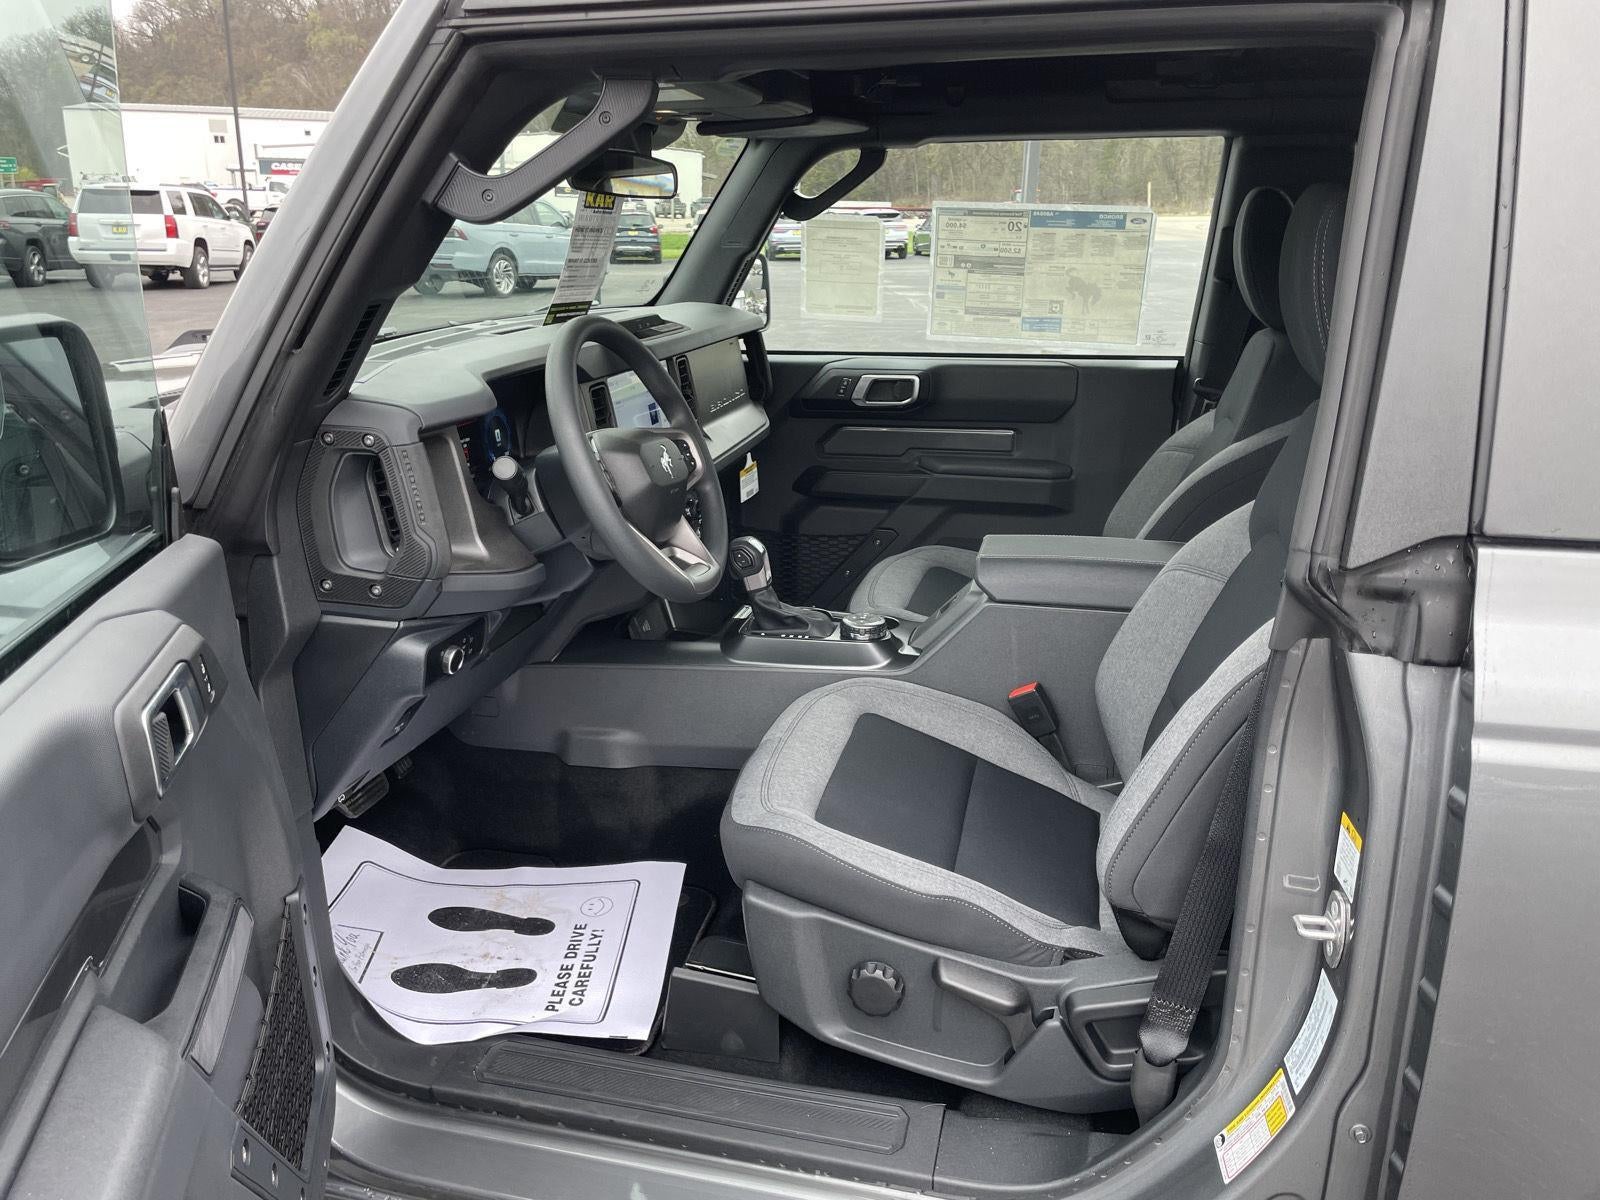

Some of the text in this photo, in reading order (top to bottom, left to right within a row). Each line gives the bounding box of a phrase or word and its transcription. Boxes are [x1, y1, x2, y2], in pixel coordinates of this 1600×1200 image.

[585, 191, 615, 208] KAR
[544, 923, 588, 1012] PLEASE DRIVE
[568, 929, 605, 1007] CAREFULLY!
